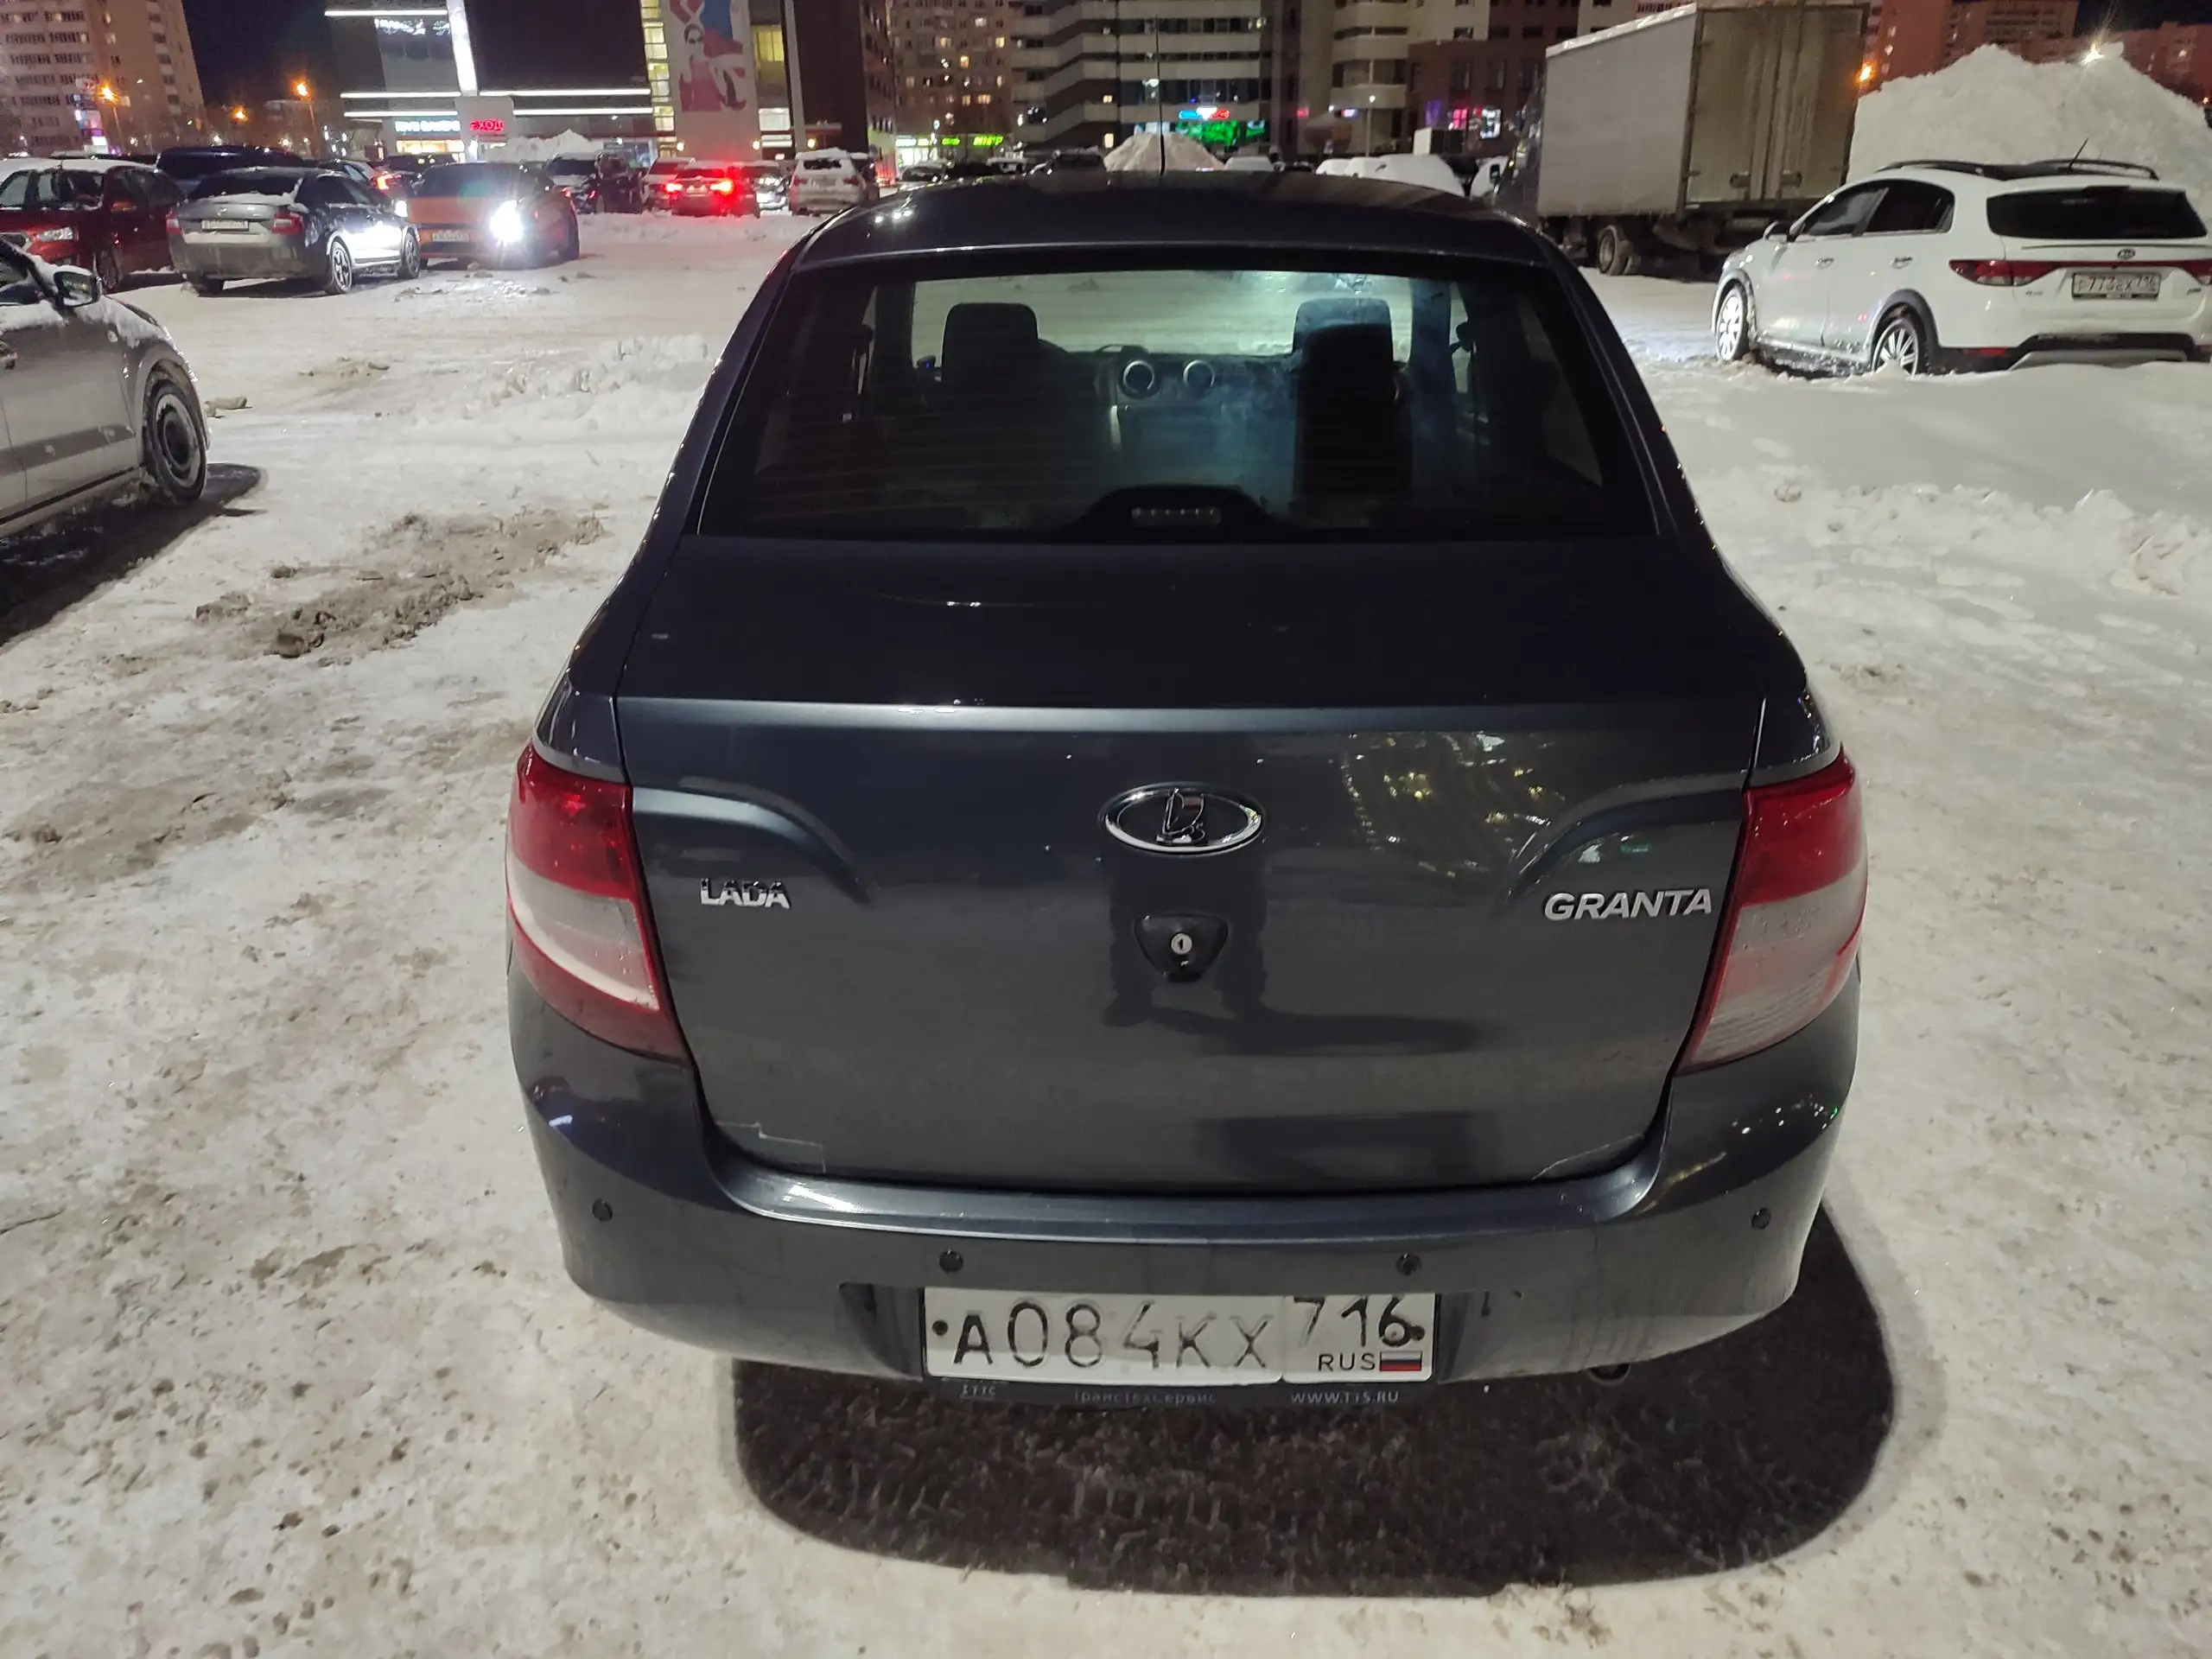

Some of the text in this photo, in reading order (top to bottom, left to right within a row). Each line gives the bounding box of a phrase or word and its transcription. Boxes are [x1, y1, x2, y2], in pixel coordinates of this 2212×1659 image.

[701, 878, 791, 909] LADA
[1544, 887, 1713, 921] GRANTA
[1294, 1296, 1412, 1347] 716
[1318, 1352, 1376, 1371] RUS
